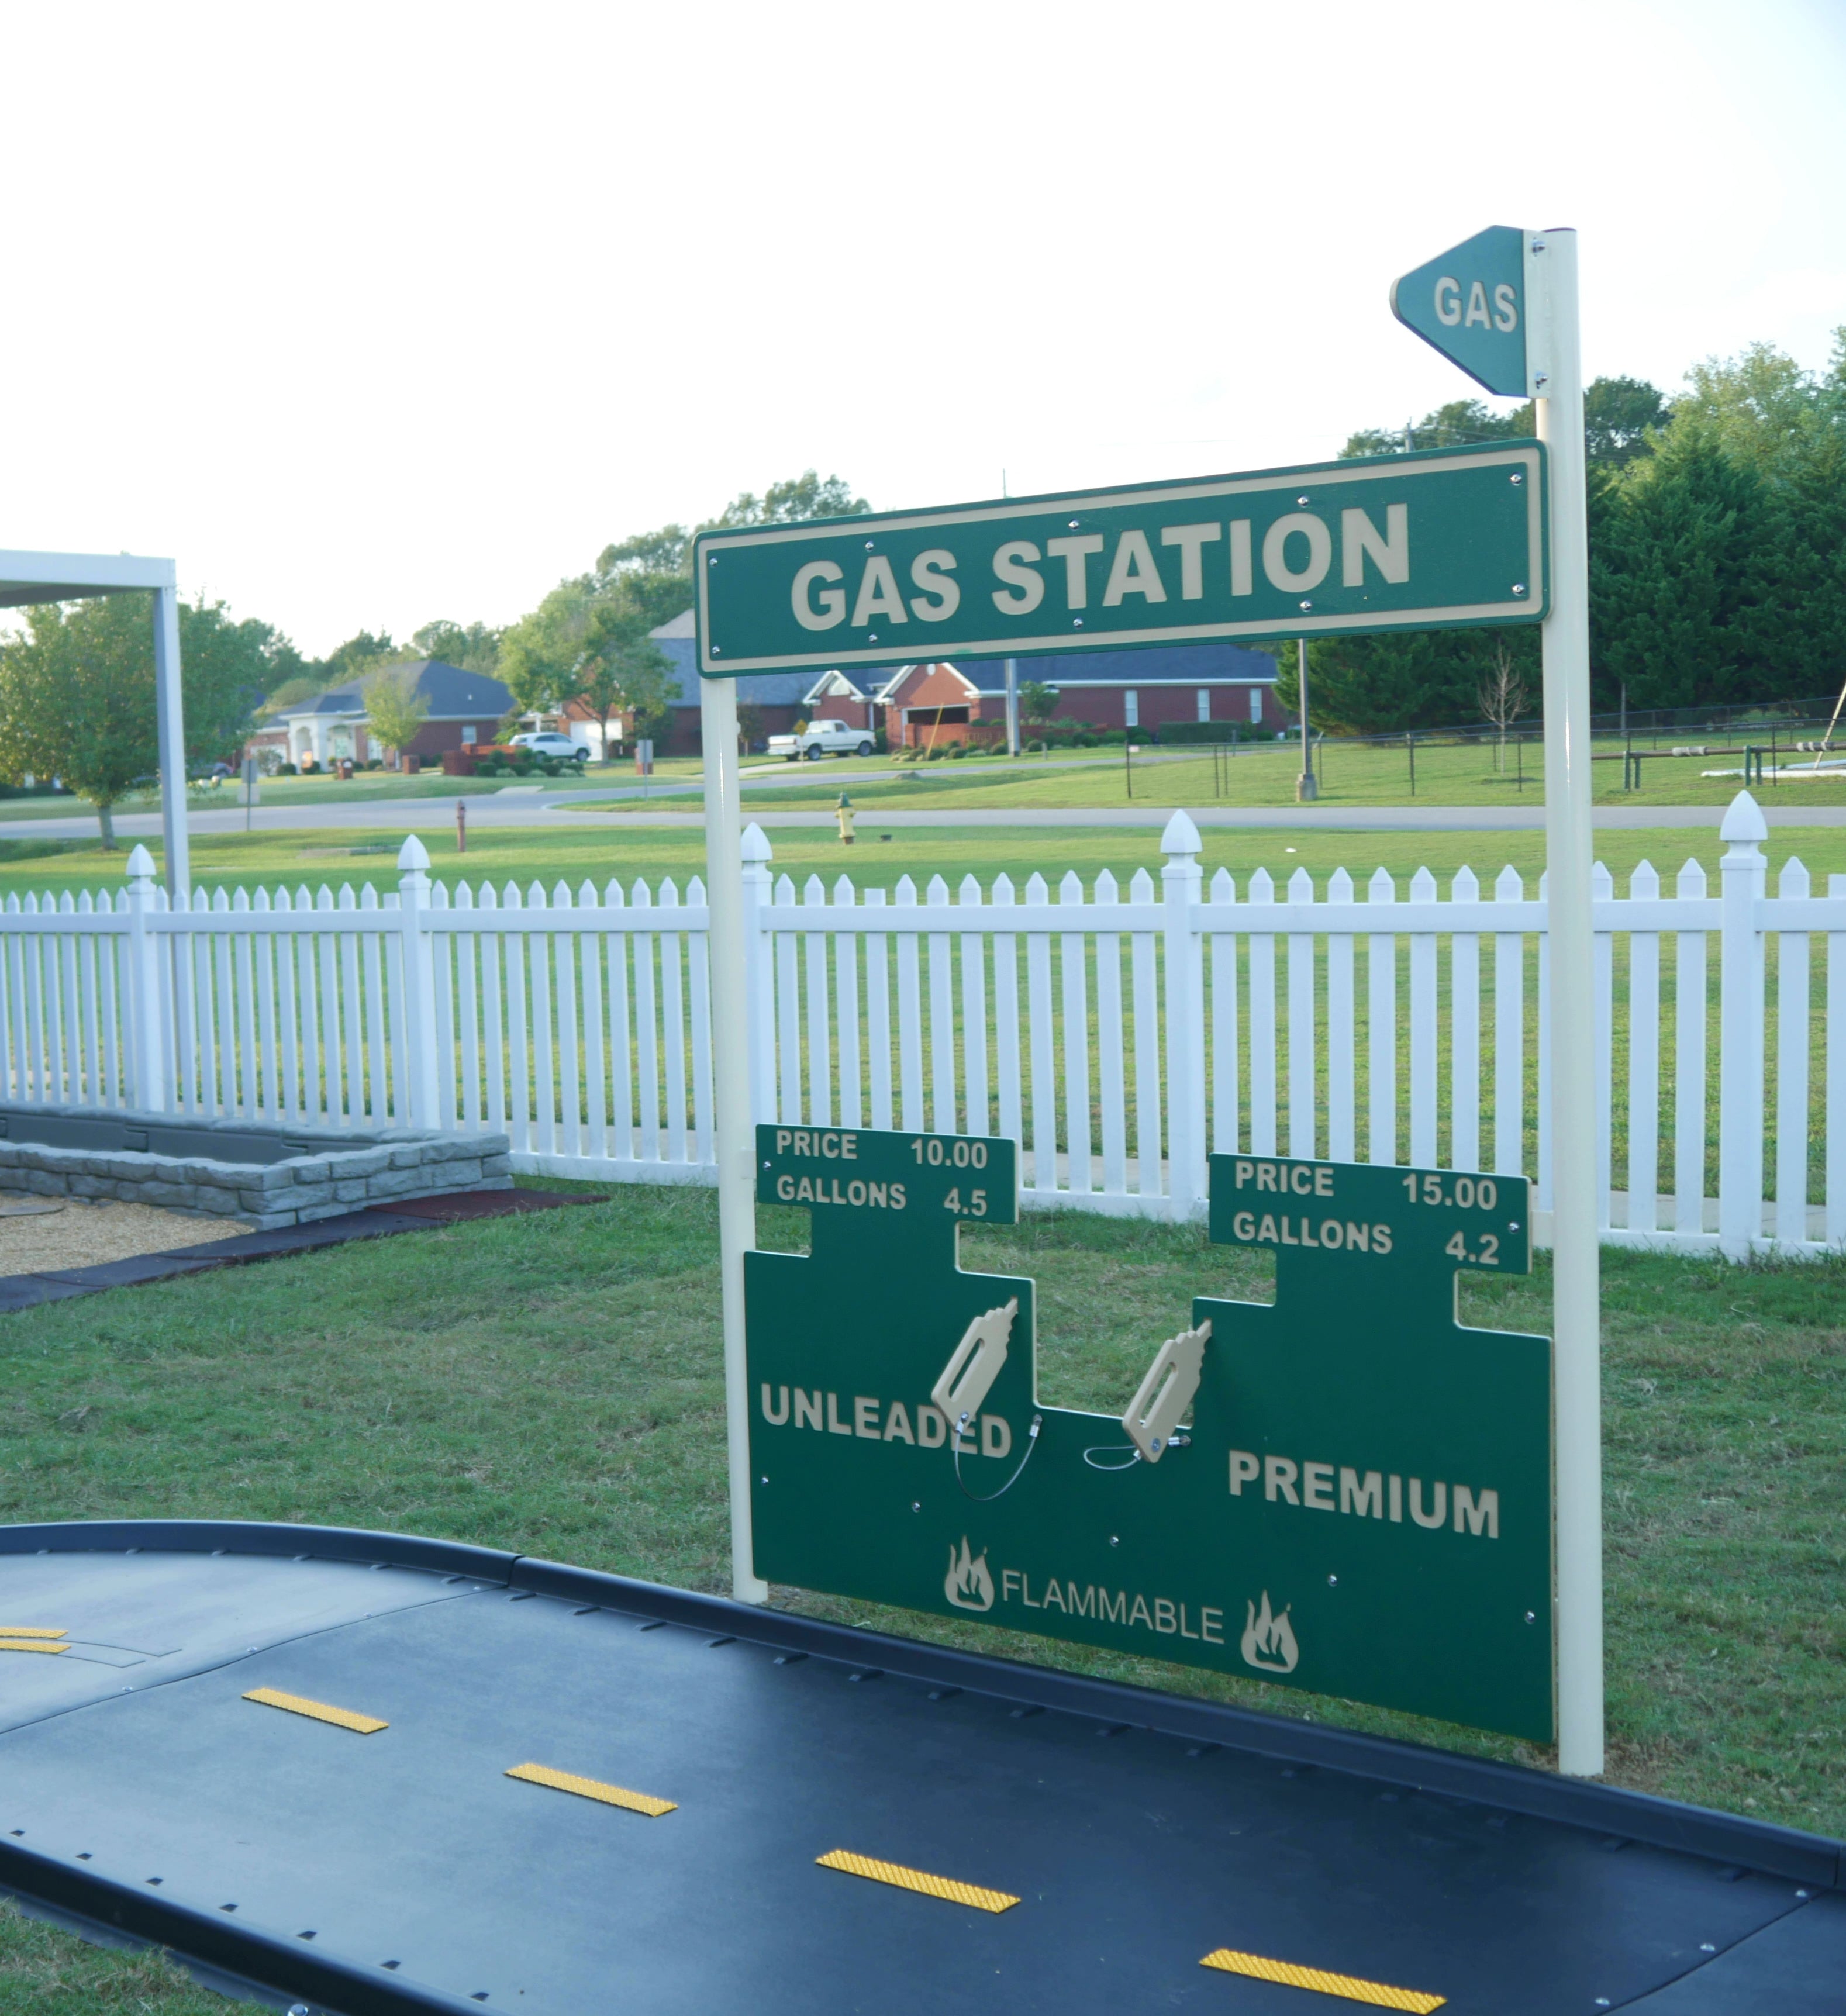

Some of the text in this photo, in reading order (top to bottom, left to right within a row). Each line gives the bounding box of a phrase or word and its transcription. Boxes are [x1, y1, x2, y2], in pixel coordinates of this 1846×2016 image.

[1433, 277, 1518, 333] GAS
[791, 503, 1410, 631] GAS STATION
[775, 1129, 988, 1169] PRICE 10.00
[776, 1174, 988, 1217] GALLONS 4.5
[1234, 1160, 1498, 1211] PRICE 15.00
[1233, 1211, 1500, 1265] GALLONS 4.2
[1229, 1449, 1499, 1539] PREMIUM
[1001, 1568, 1225, 1645] FLAMMABLE
